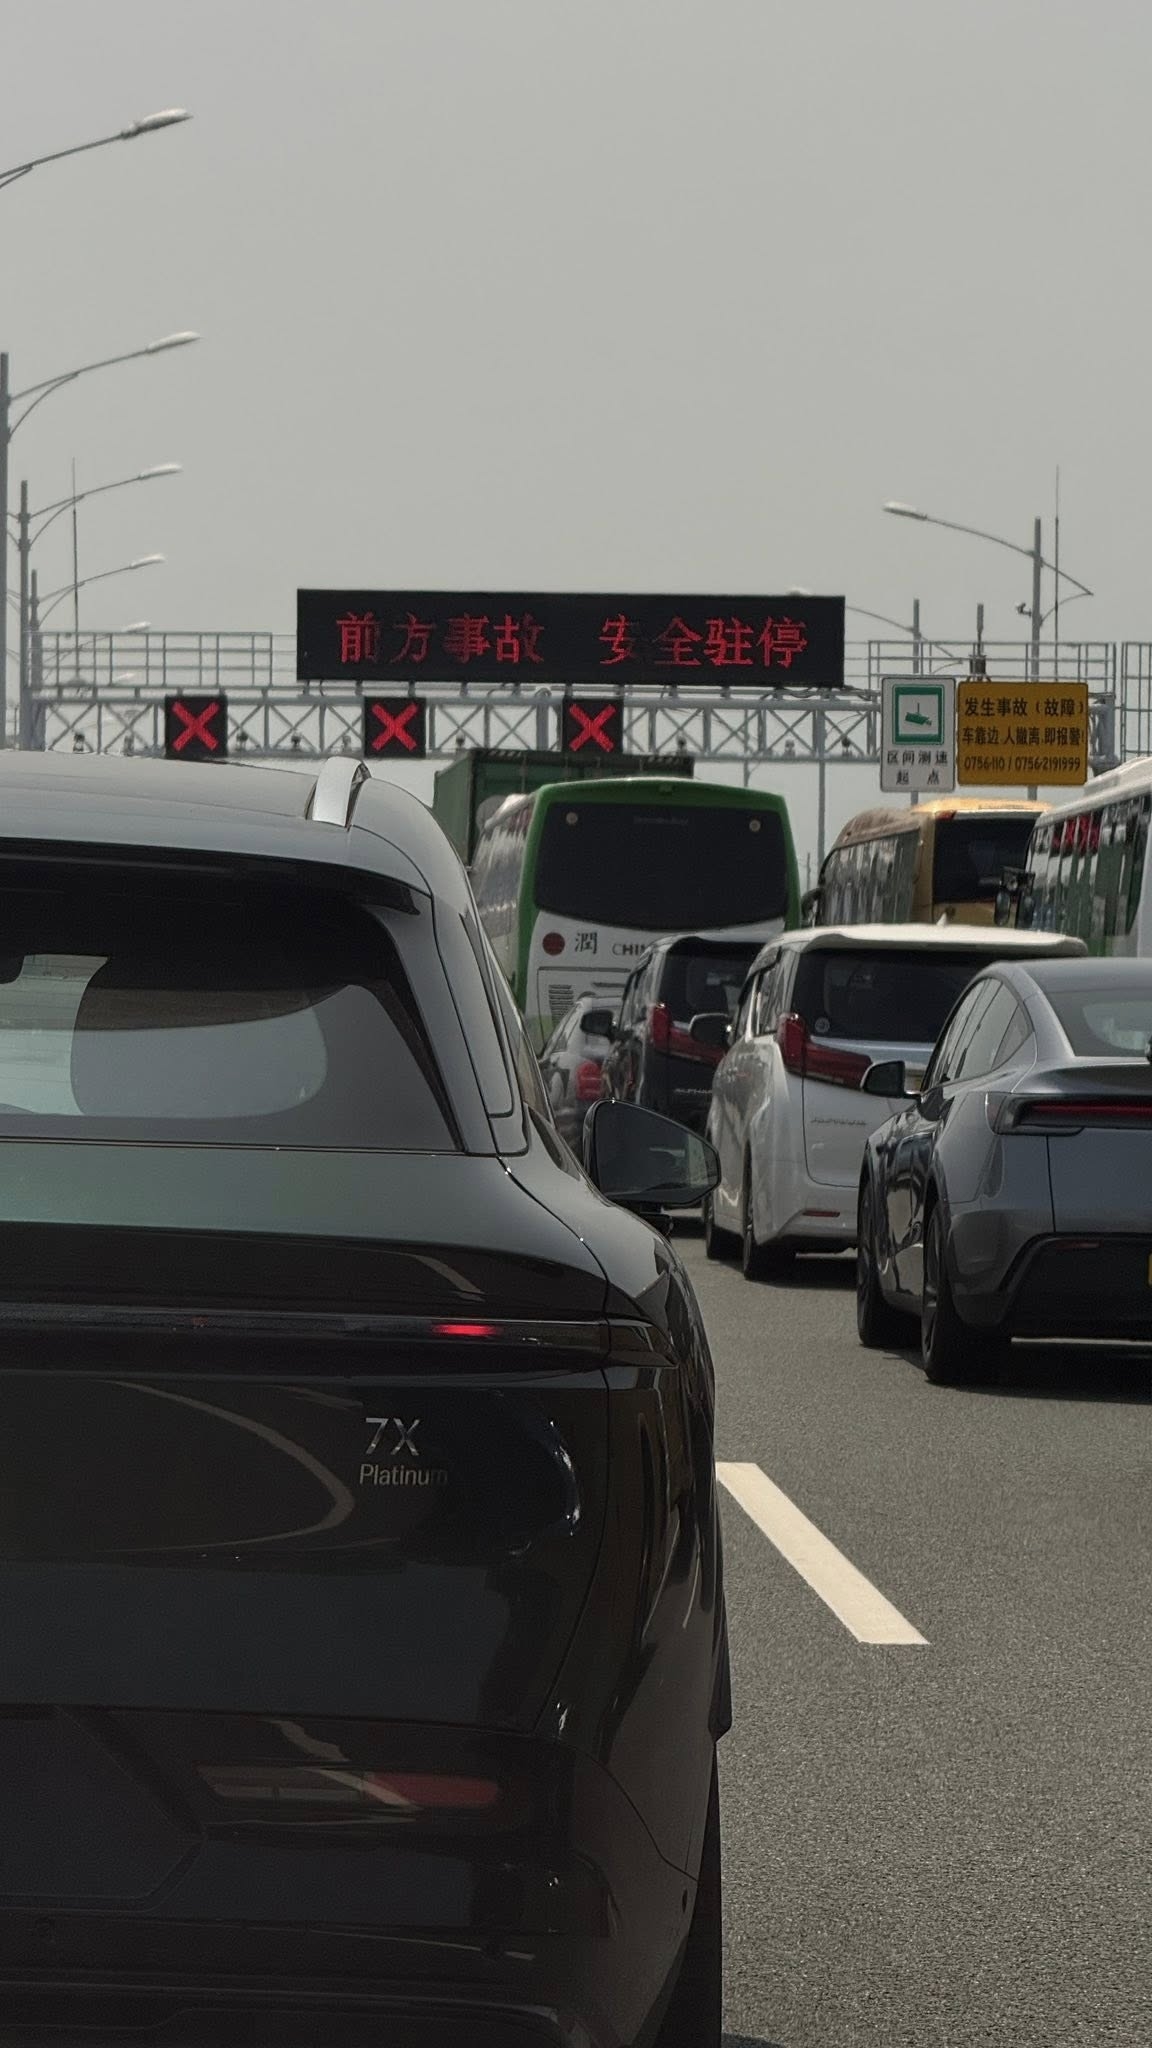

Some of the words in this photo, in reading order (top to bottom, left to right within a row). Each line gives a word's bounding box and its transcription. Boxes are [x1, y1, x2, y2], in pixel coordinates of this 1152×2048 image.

[334, 611, 545, 664] 前方事故
[598, 613, 808, 668] 安全驻停
[887, 750, 948, 766] 区间测速
[574, 932, 598, 954] 潤
[365, 1417, 420, 1456] 7X
[360, 1463, 448, 1486] Platinum
